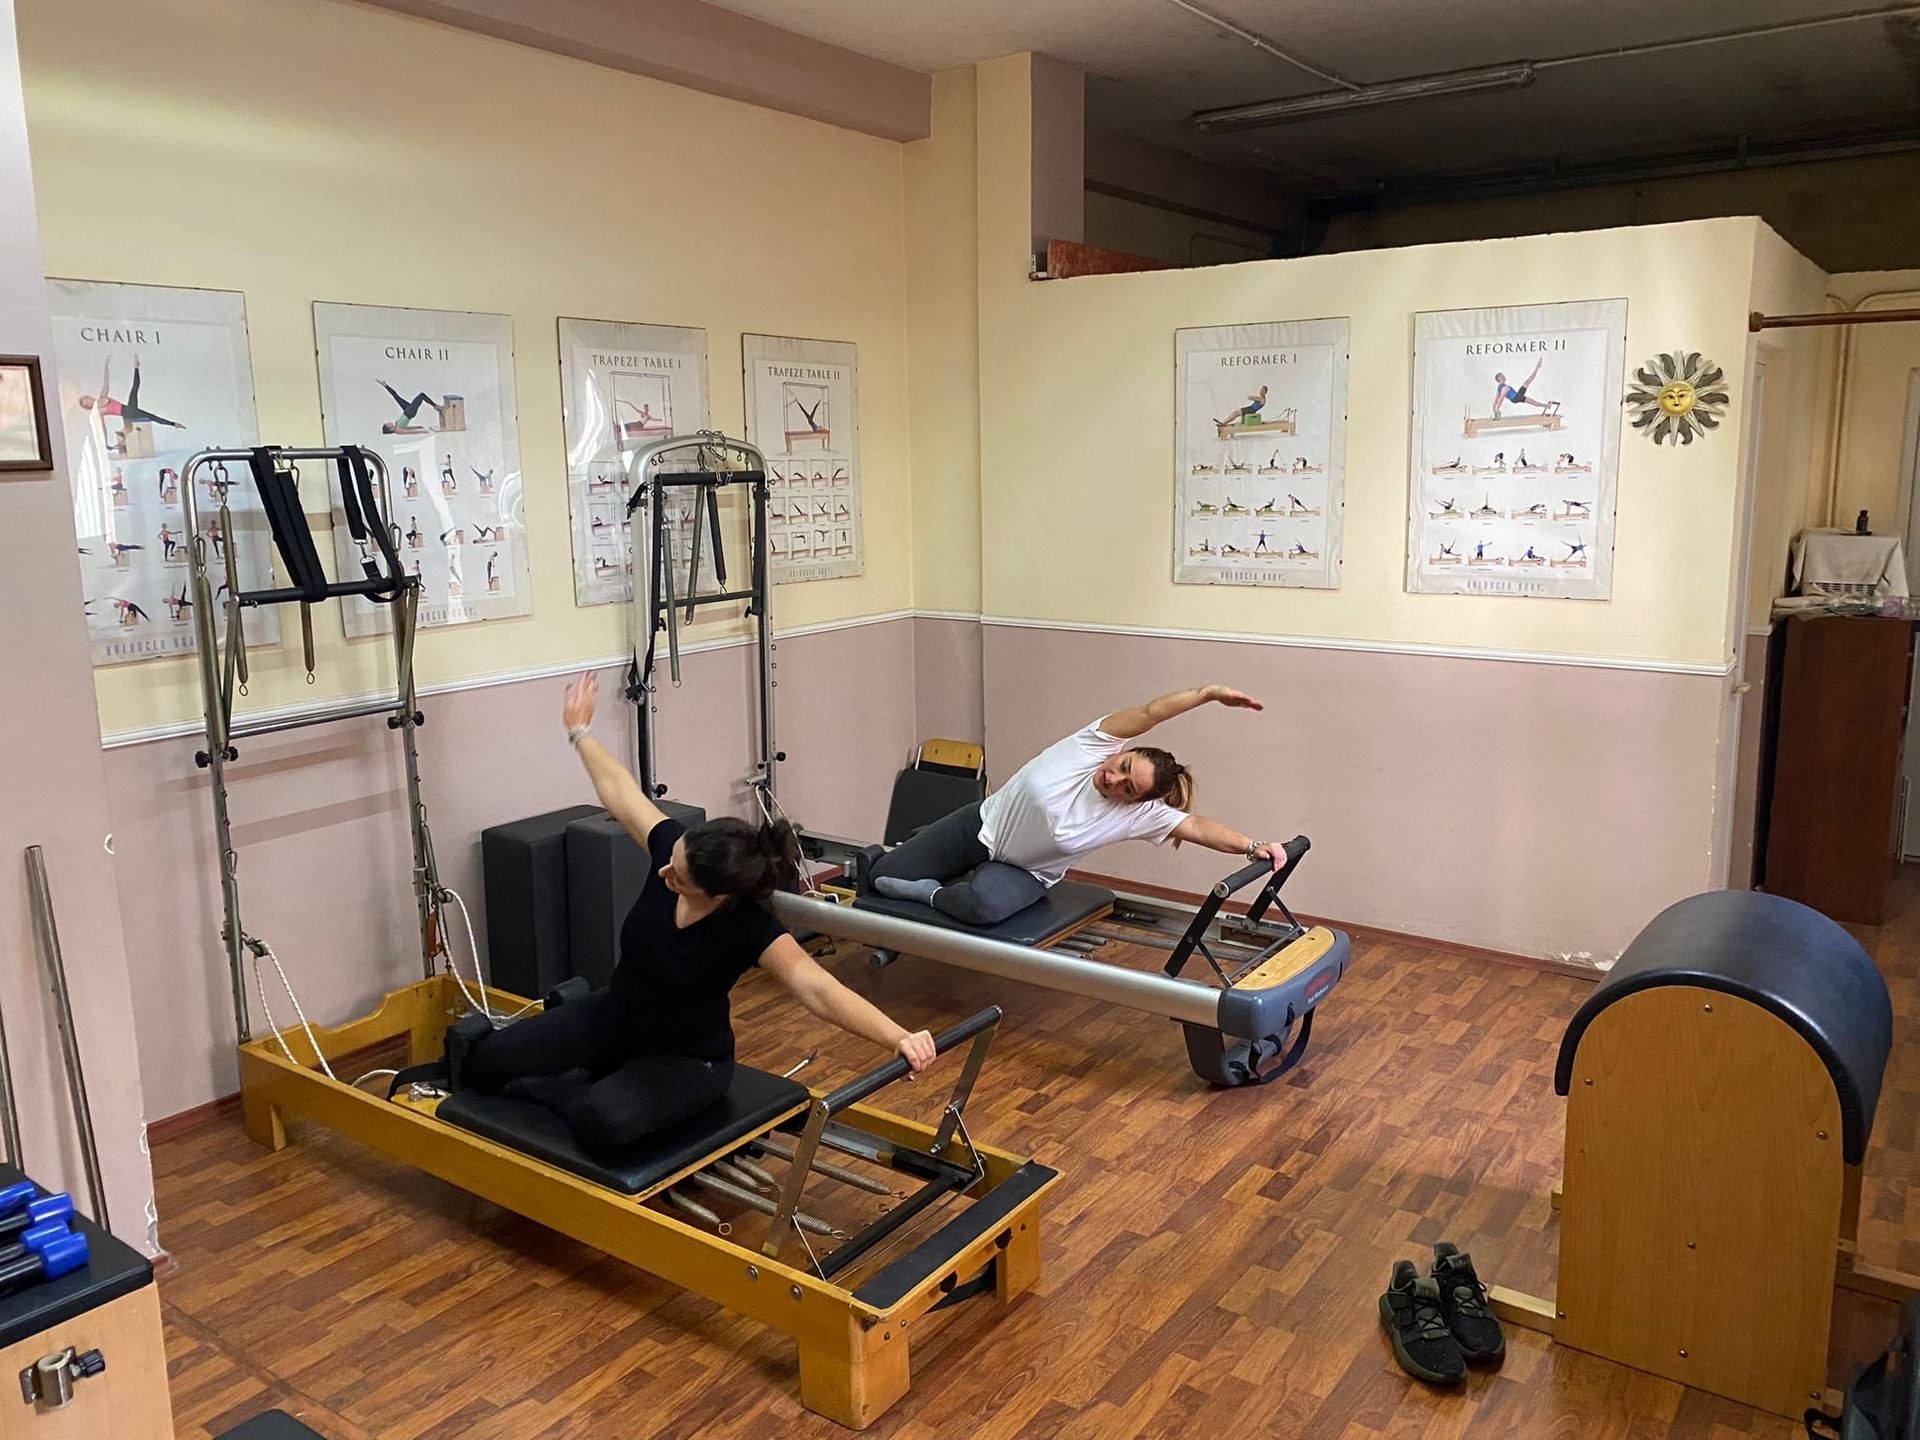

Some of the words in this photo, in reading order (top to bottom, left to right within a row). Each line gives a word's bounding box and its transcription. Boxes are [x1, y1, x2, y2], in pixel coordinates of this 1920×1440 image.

[81, 327, 147, 344] CHAIR
[155, 331, 160, 344] I
[385, 346, 433, 360] CHAIR
[438, 349, 448, 361] II
[1466, 340, 1547, 355] REFORMER
[1554, 339, 1565, 350] II
[592, 354, 638, 367] TRAPEZE
[643, 357, 673, 369] TABLE
[1221, 353, 1287, 367] REFORMER
[768, 366, 803, 378] TRAPEZE
[807, 369, 831, 380] TABLE
[834, 371, 840, 380] II
